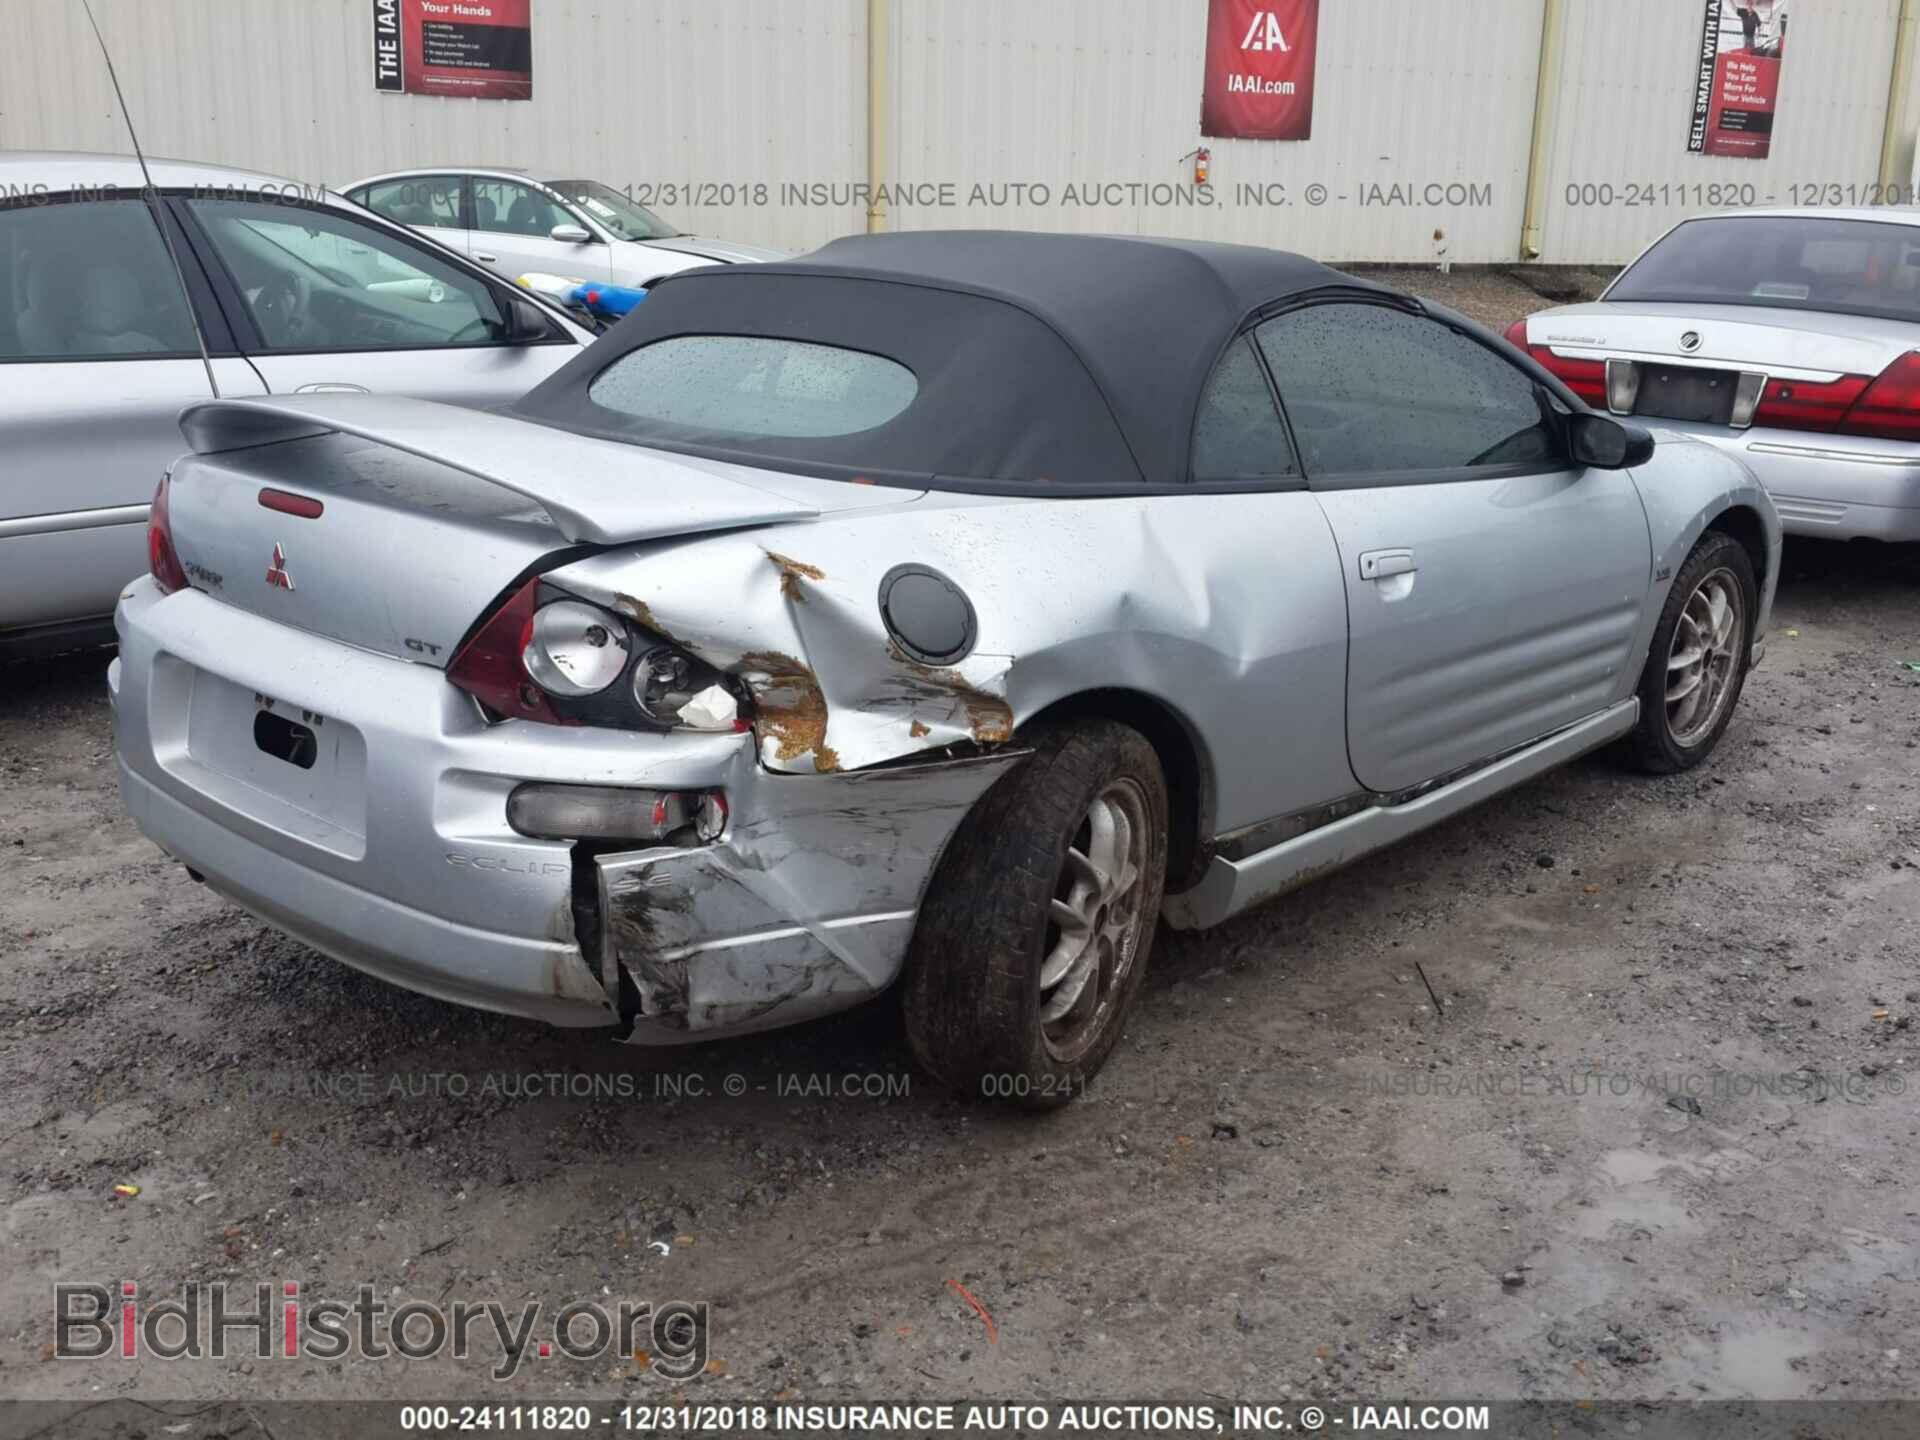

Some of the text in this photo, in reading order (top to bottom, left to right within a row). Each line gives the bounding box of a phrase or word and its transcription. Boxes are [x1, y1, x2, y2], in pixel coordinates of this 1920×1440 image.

[421, 2, 492, 16] Your Hands
[379, 40, 398, 79] THE
[1691, 0, 1721, 149] SELL SMART WITH IA
[1739, 63, 1756, 73] Help
[1725, 72, 1739, 81] You
[1228, 73, 1295, 95] IAAI.com
[1723, 82, 1757, 94] More For
[1722, 93, 1766, 105] Your Vehicle
[404, 637, 442, 657] GT
